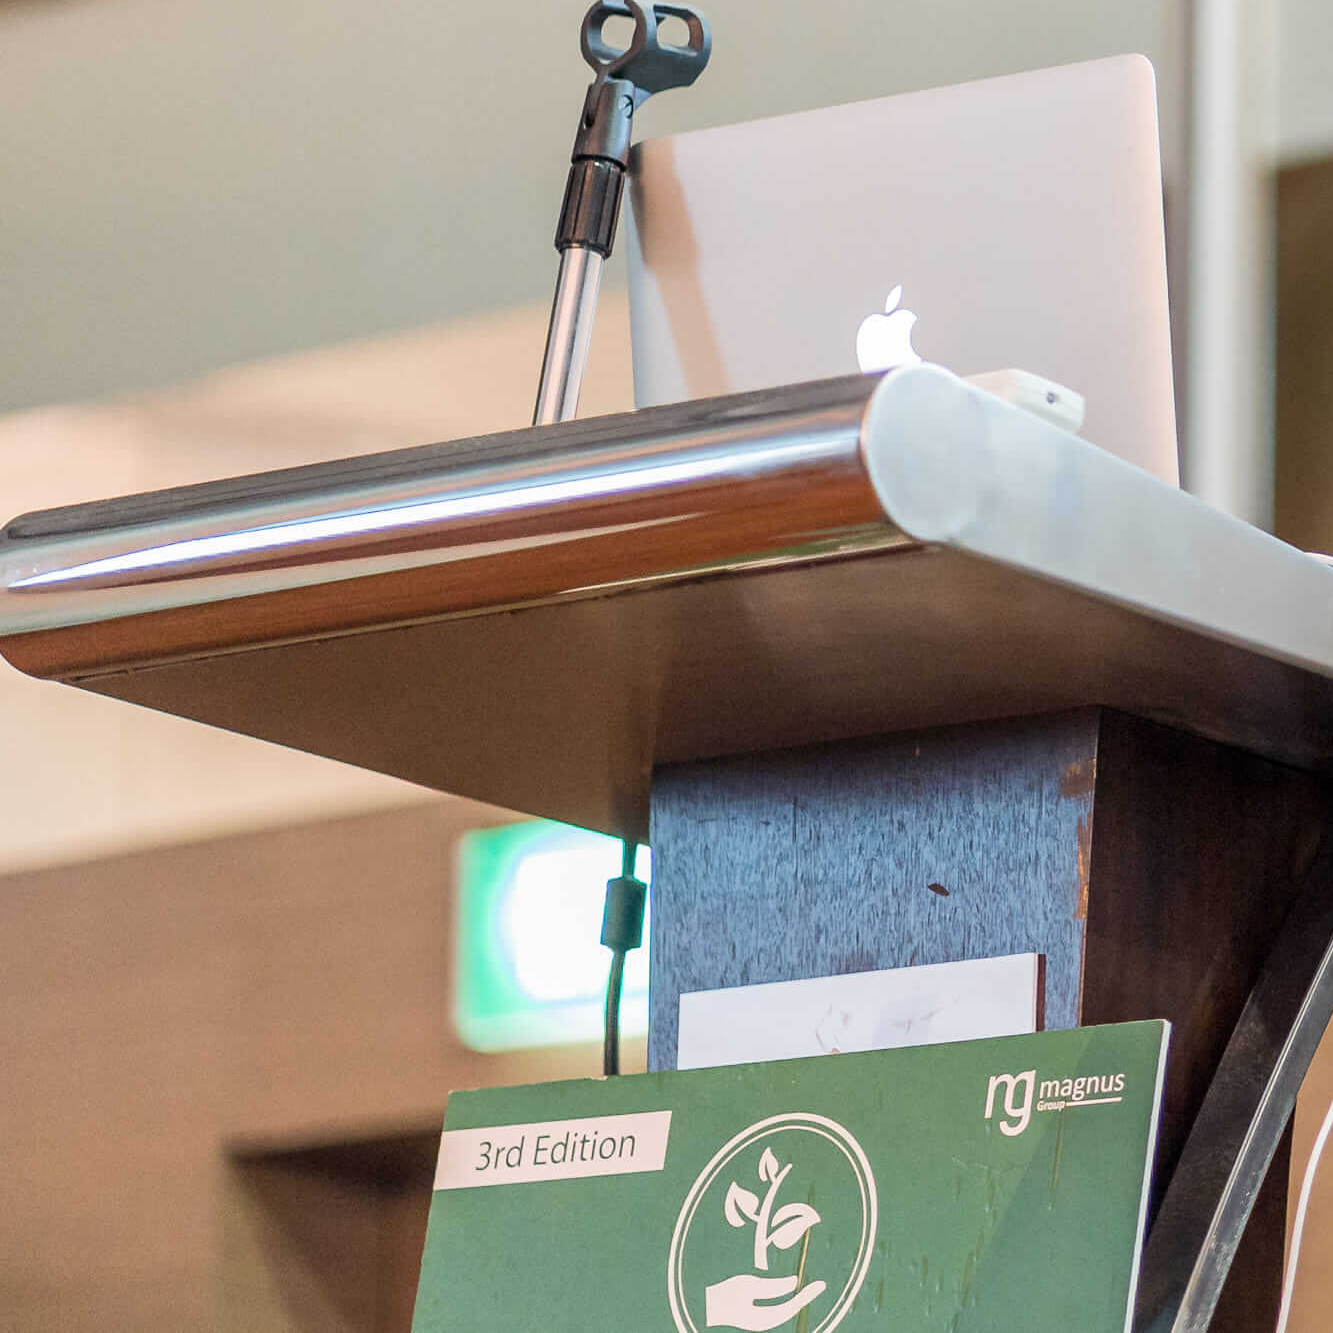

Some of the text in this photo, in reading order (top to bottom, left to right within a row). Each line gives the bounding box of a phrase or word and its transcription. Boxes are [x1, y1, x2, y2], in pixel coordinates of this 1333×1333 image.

[1039, 1073, 1125, 1101] magnus
[1037, 1100, 1065, 1112] Group
[475, 1130, 636, 1171] 3rd Edition
